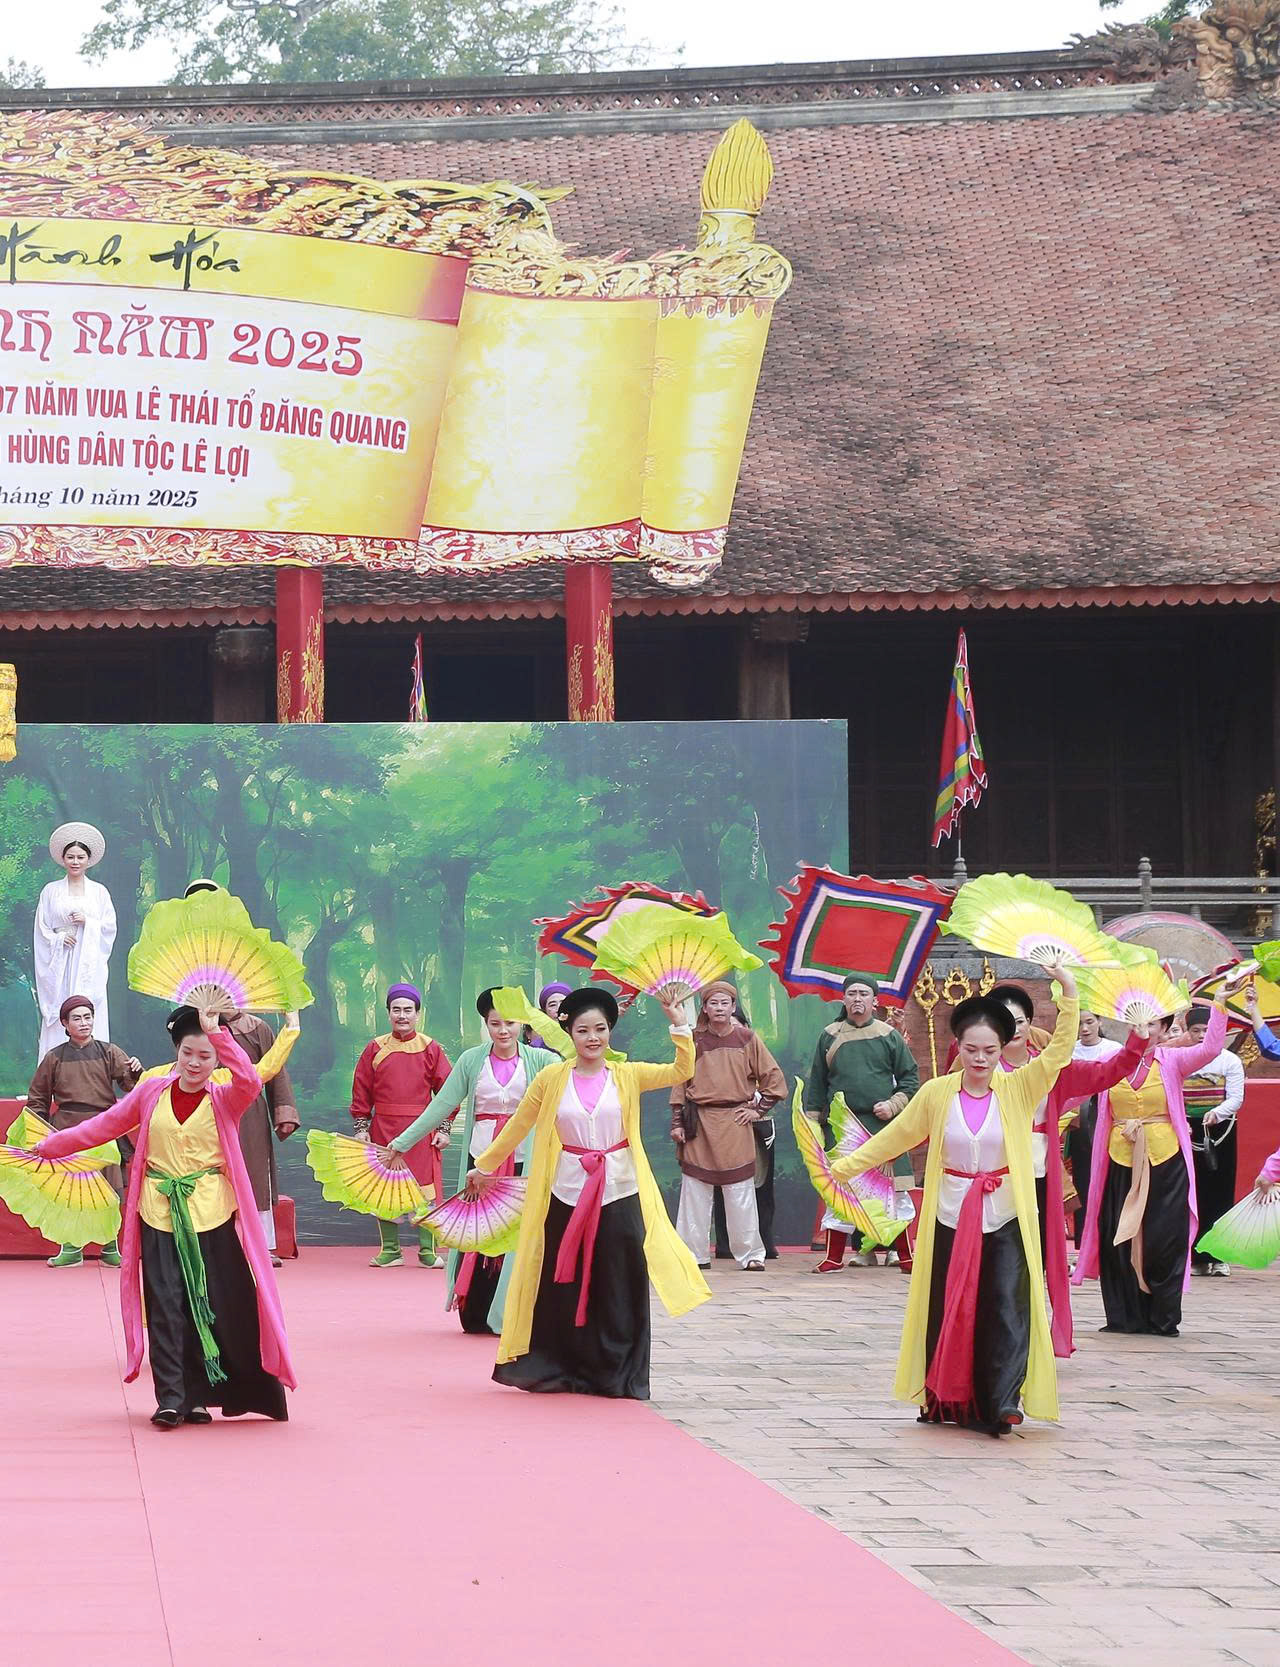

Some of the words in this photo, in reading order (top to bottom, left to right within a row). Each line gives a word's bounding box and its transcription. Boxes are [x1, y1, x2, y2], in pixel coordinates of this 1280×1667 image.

[149, 228, 240, 290] Hóa
[73, 304, 214, 361] NĂM
[229, 323, 363, 377] 2025
[24, 379, 78, 418] NĂM
[86, 388, 128, 420] VUA
[135, 385, 161, 423] LÊ
[169, 388, 219, 426] THÁI
[227, 388, 256, 430] TỔ
[260, 399, 323, 437] ĐĂNG
[330, 410, 407, 451] QUANG
[8, 427, 70, 466] HÙNG
[78, 430, 126, 468] DÂN
[133, 434, 176, 475] TỘC
[181, 437, 207, 474] LÊ
[214, 445, 250, 484] LỢI
[59, 488, 85, 506] 10
[90, 487, 141, 507] năm
[145, 489, 199, 509] 2025
